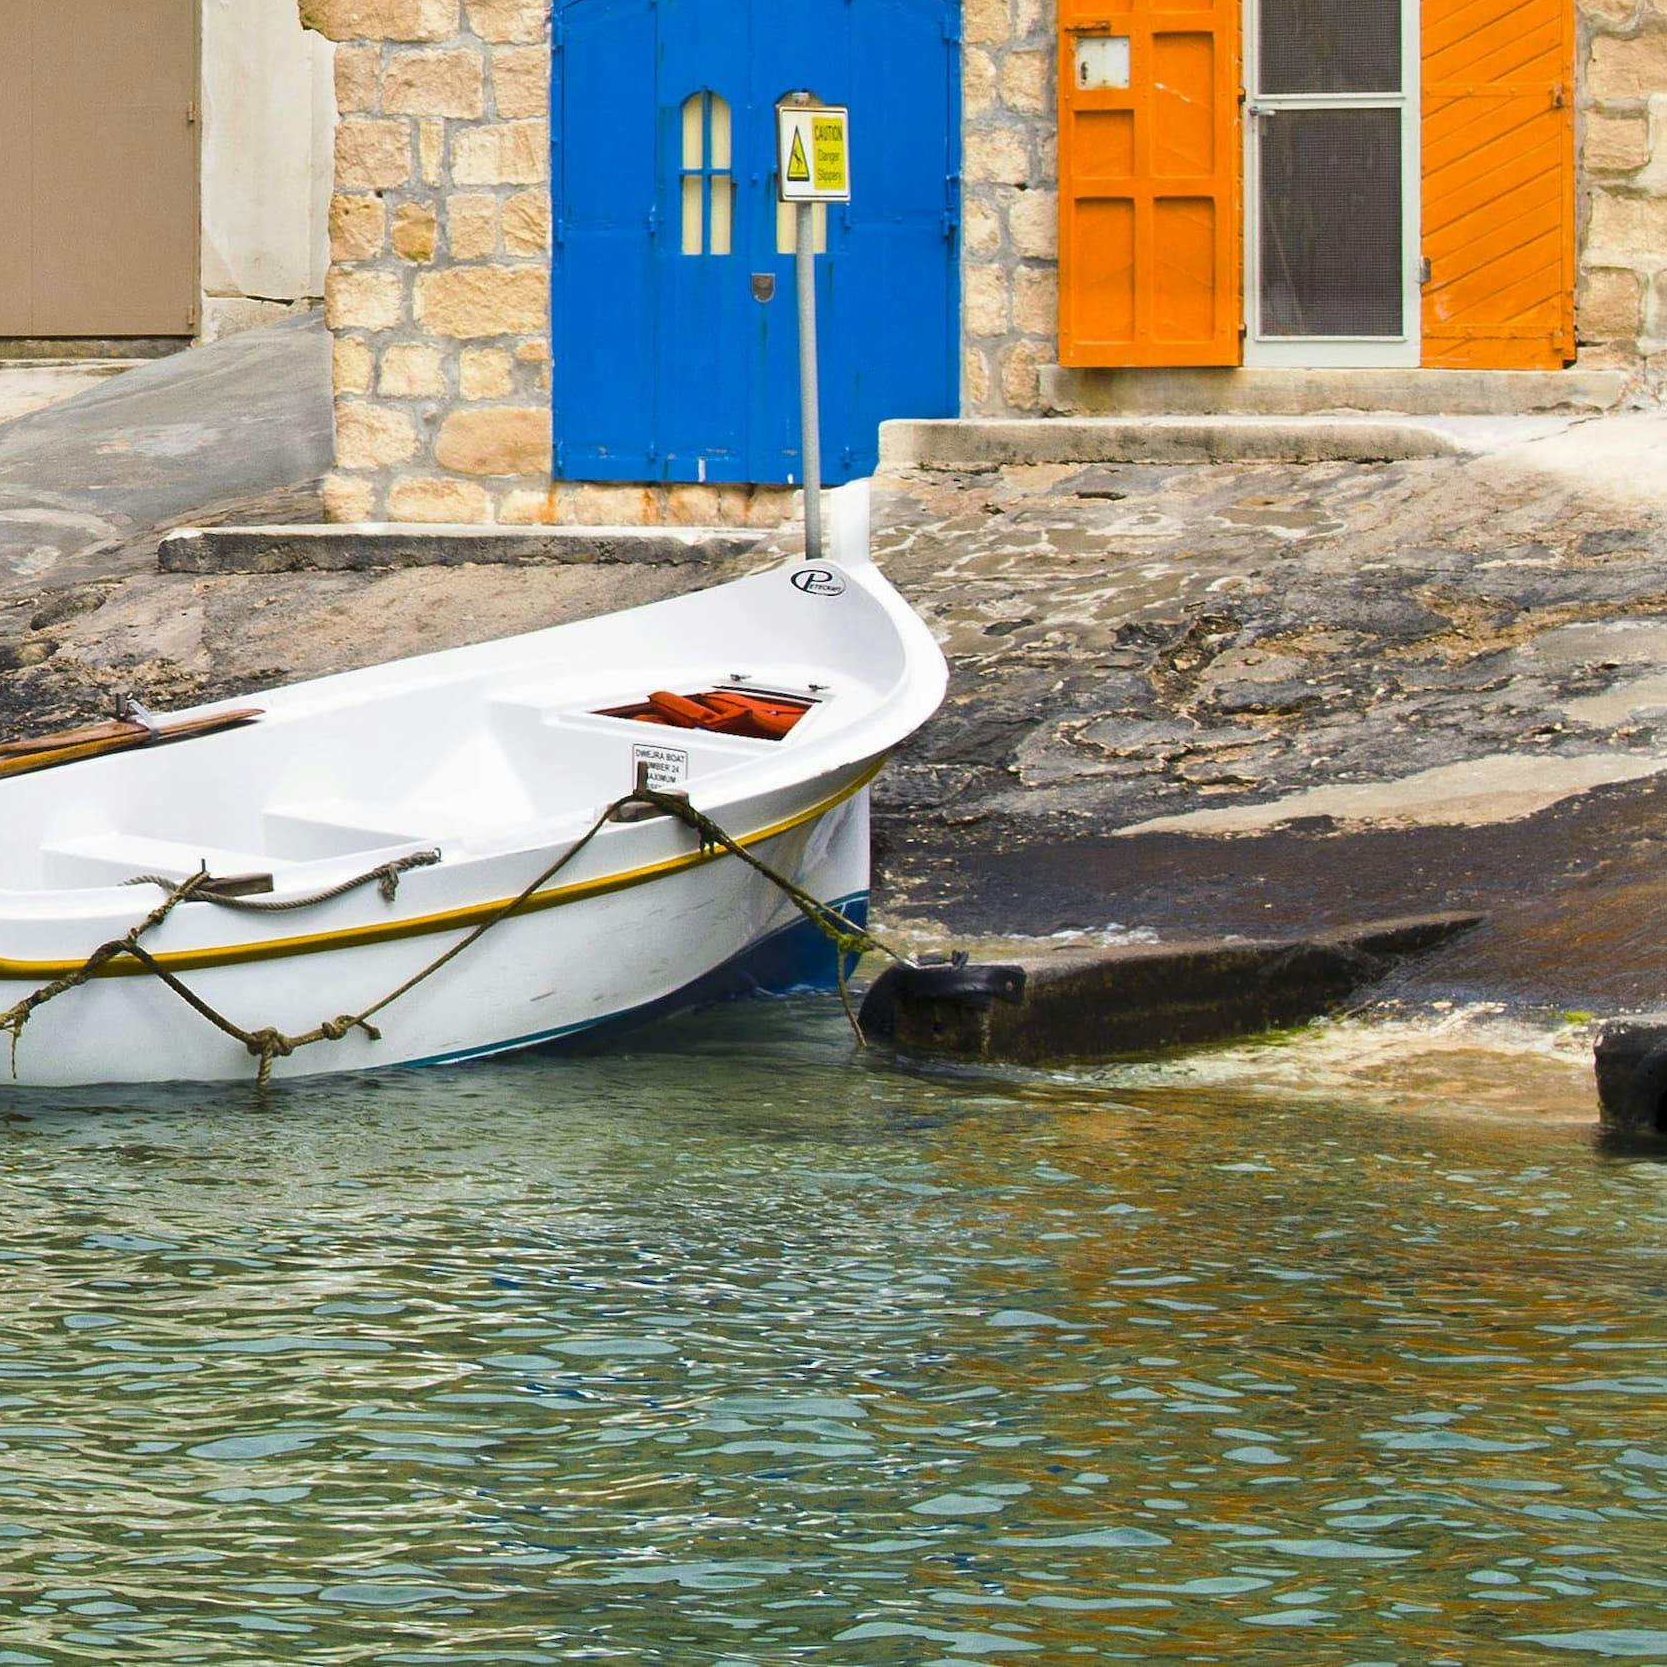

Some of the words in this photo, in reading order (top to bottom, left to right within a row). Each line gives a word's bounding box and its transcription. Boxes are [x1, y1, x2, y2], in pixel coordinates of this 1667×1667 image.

[814, 124, 844, 141] CAUTION
[818, 148, 840, 165] Danger
[817, 168, 842, 183] Slippery
[665, 753, 685, 763] BOAT
[647, 773, 676, 783] AXIMUM
